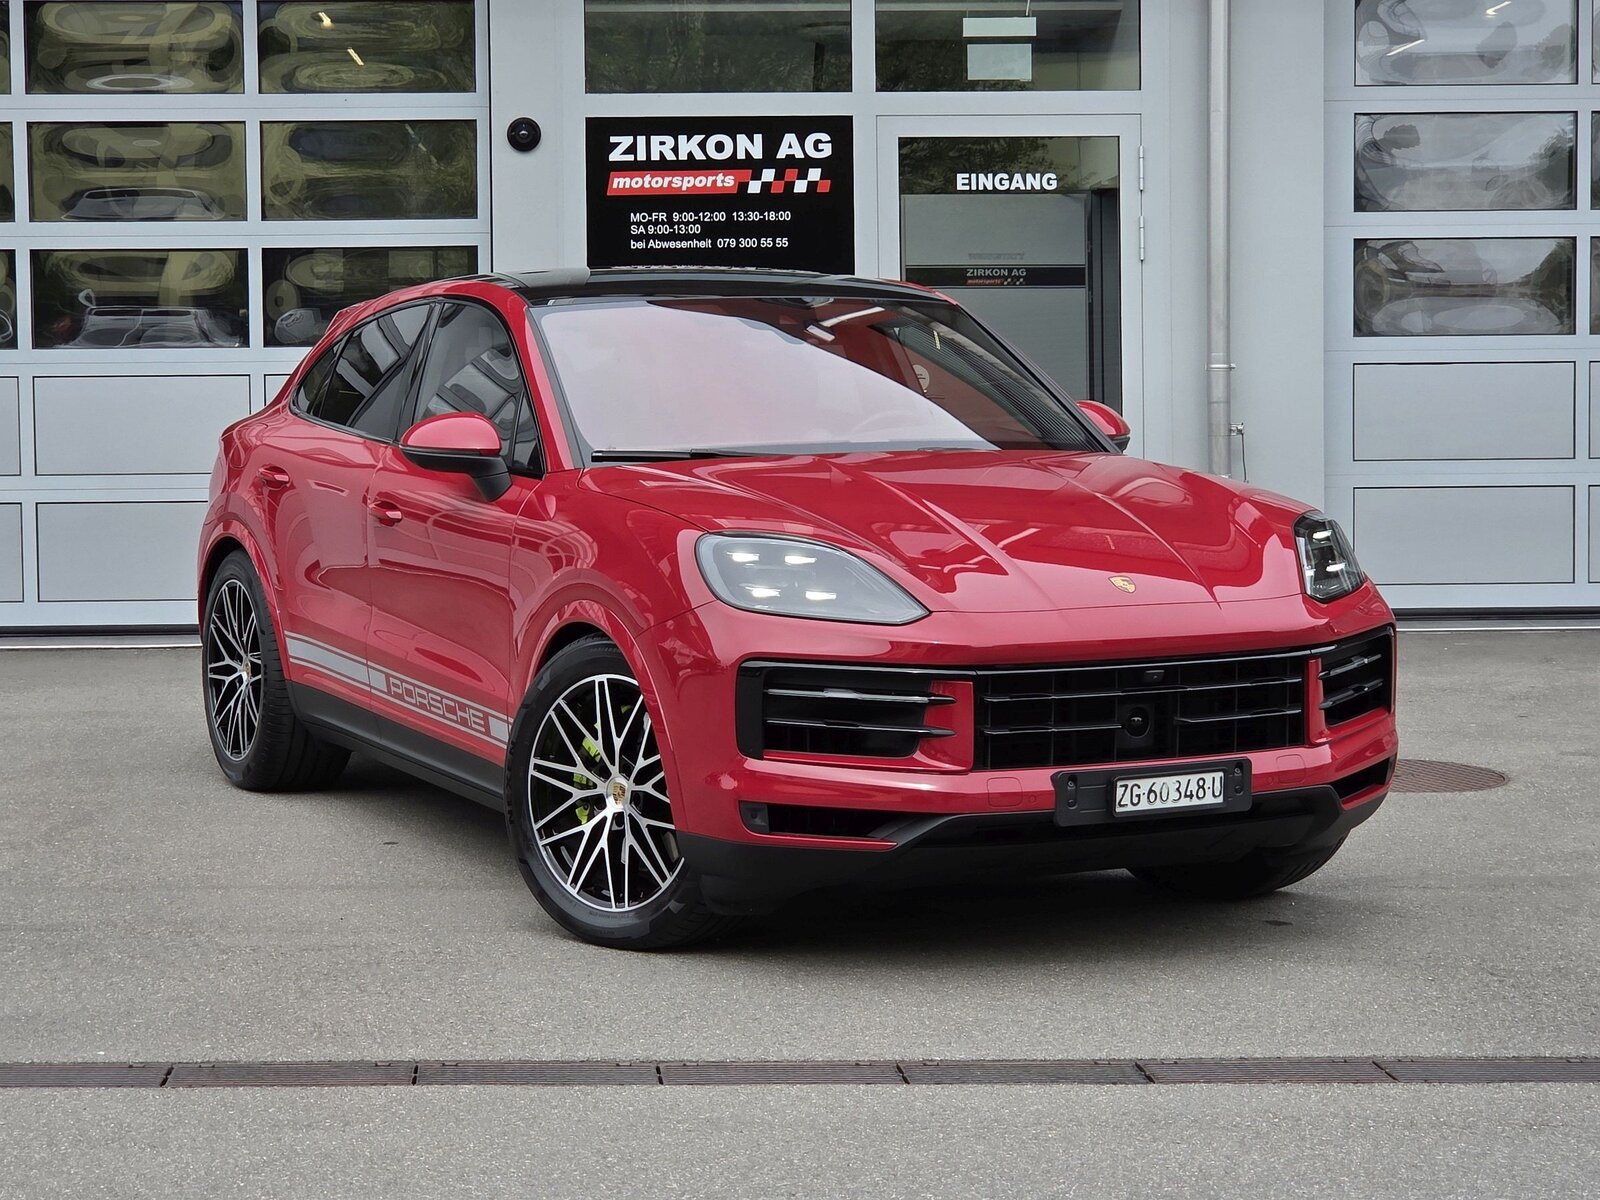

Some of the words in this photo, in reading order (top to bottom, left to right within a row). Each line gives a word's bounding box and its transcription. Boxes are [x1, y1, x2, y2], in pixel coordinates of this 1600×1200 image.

[608, 134, 763, 161] ZIRKON
[776, 132, 832, 159] AG
[612, 173, 735, 191] motorsports
[956, 173, 1057, 191] EINGANG
[630, 212, 668, 223] MO-FR
[672, 211, 727, 222] 9:00-12:00
[732, 211, 792, 222] 13:30-18:00
[630, 224, 646, 235] SA
[647, 224, 702, 235] 9:00-13:00
[630, 239, 646, 250] bei
[647, 239, 712, 250] Abwesenheit
[716, 238, 737, 249] 079
[738, 237, 758, 248] 300
[760, 237, 774, 248] 55
[775, 237, 789, 248] 55
[966, 268, 1009, 277] ZIRKON
[1011, 268, 1027, 277] AG
[389, 677, 486, 733] PORSCHE
